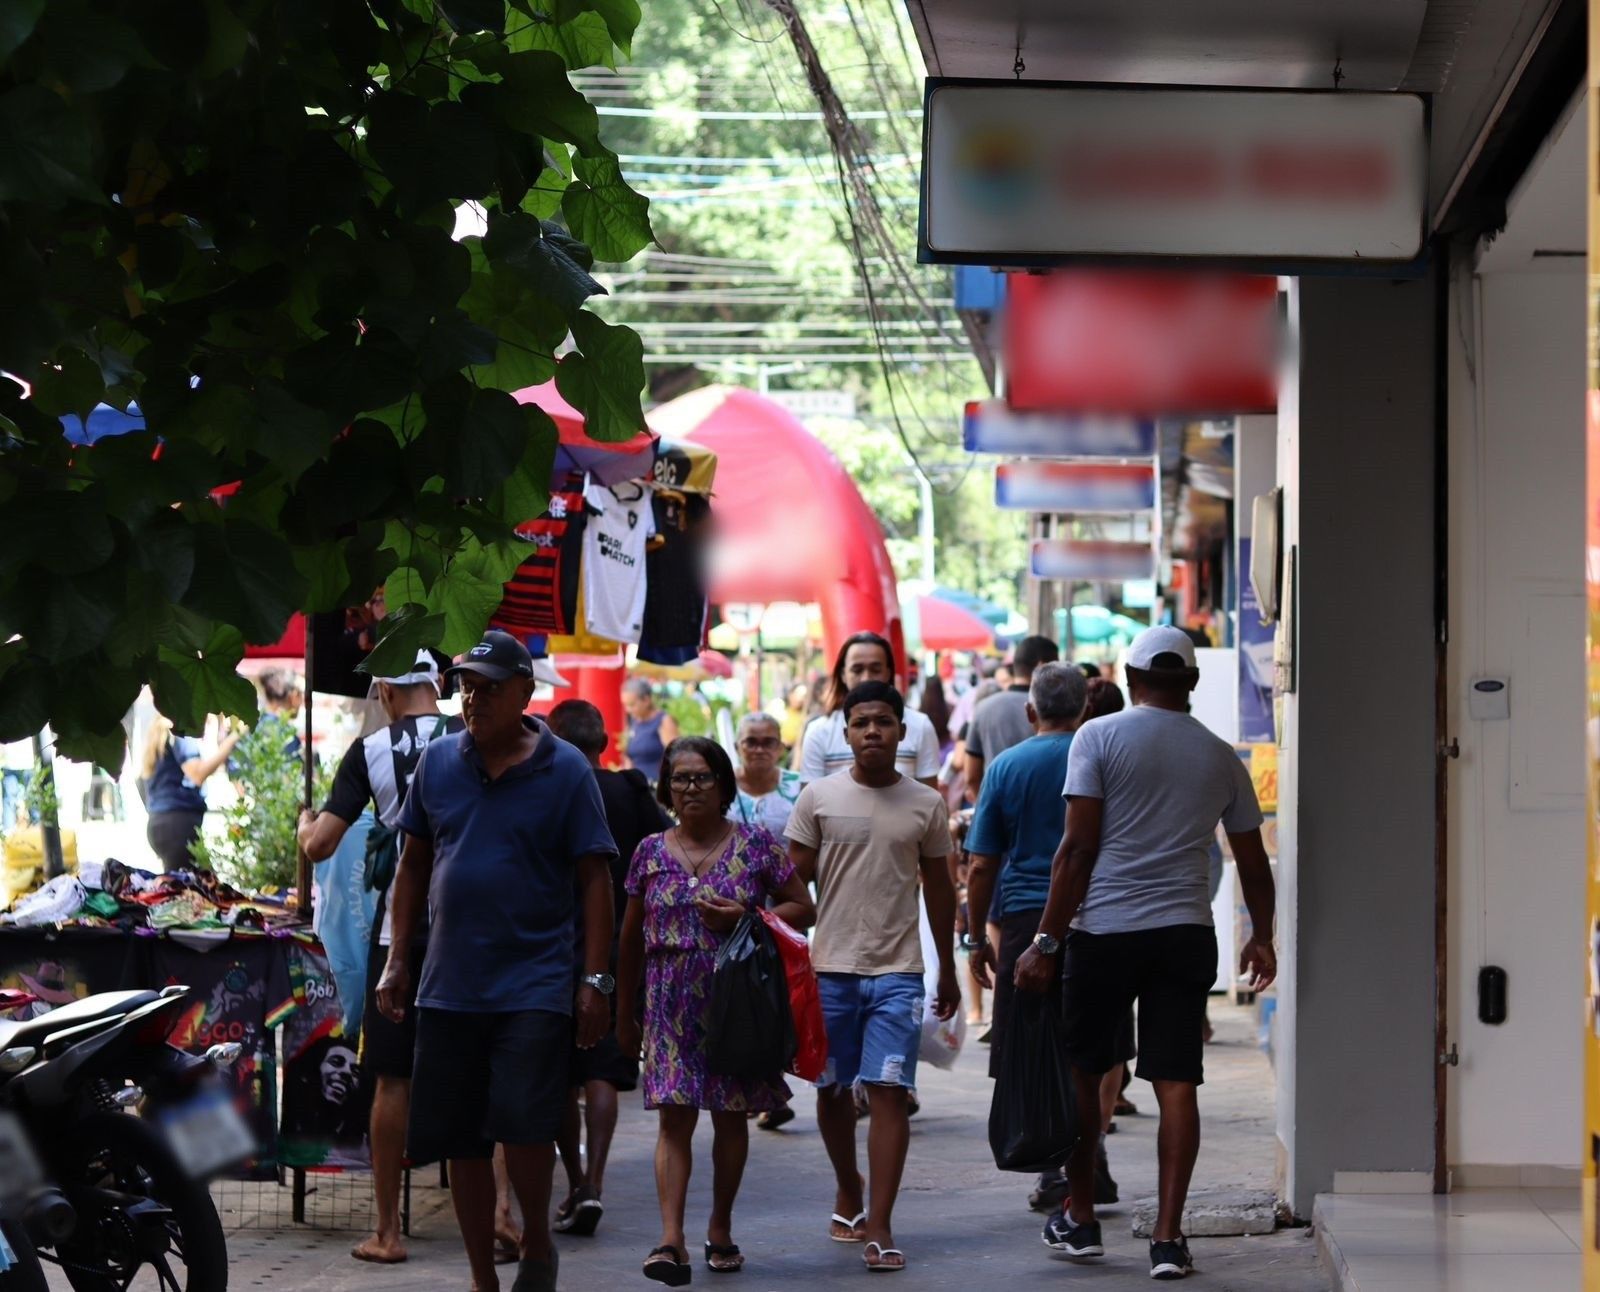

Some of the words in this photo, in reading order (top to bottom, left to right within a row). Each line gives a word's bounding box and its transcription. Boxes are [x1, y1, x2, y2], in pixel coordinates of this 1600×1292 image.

[599, 532, 622, 550] PARI
[602, 545, 636, 567] MATCH
[304, 979, 335, 1006] Bob
